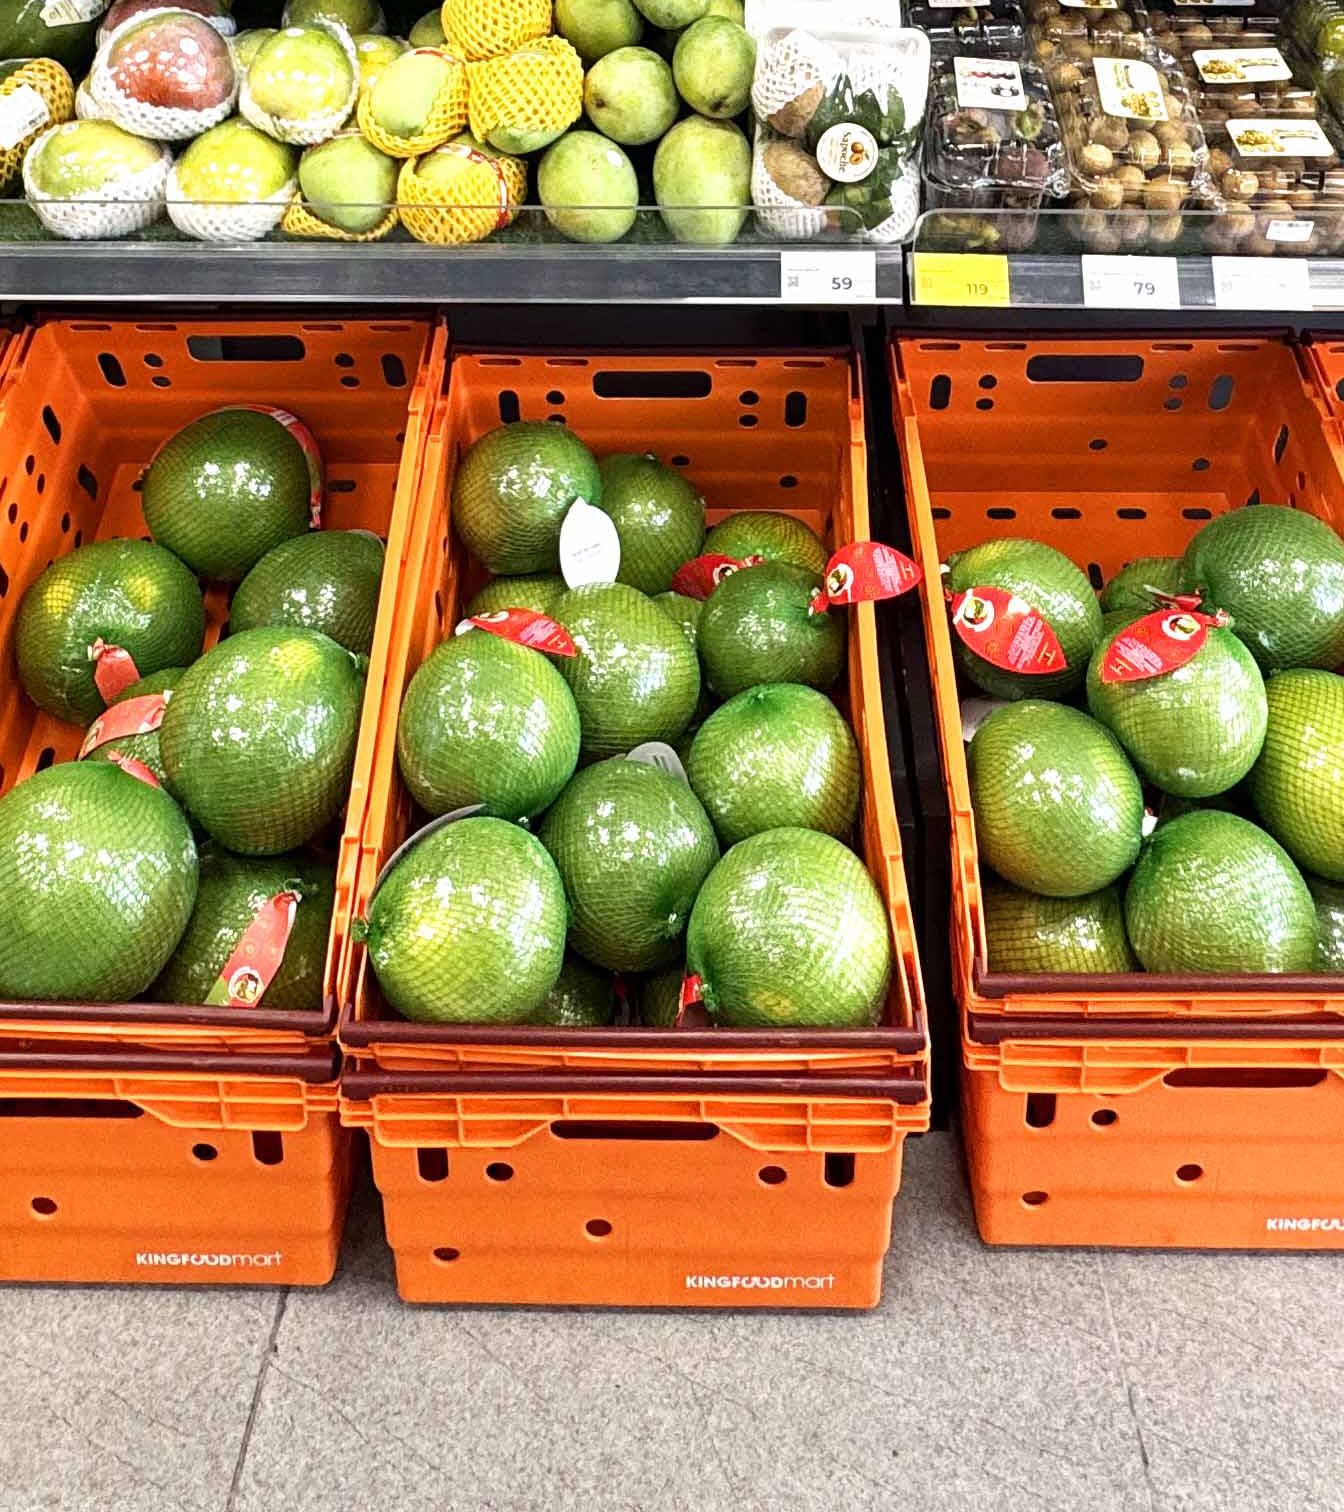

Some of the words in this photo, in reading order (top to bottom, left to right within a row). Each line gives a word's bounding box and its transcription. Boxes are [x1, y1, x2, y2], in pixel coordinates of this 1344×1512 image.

[831, 277, 853, 290] 59
[965, 283, 989, 296] 119
[1133, 281, 1155, 295] 79
